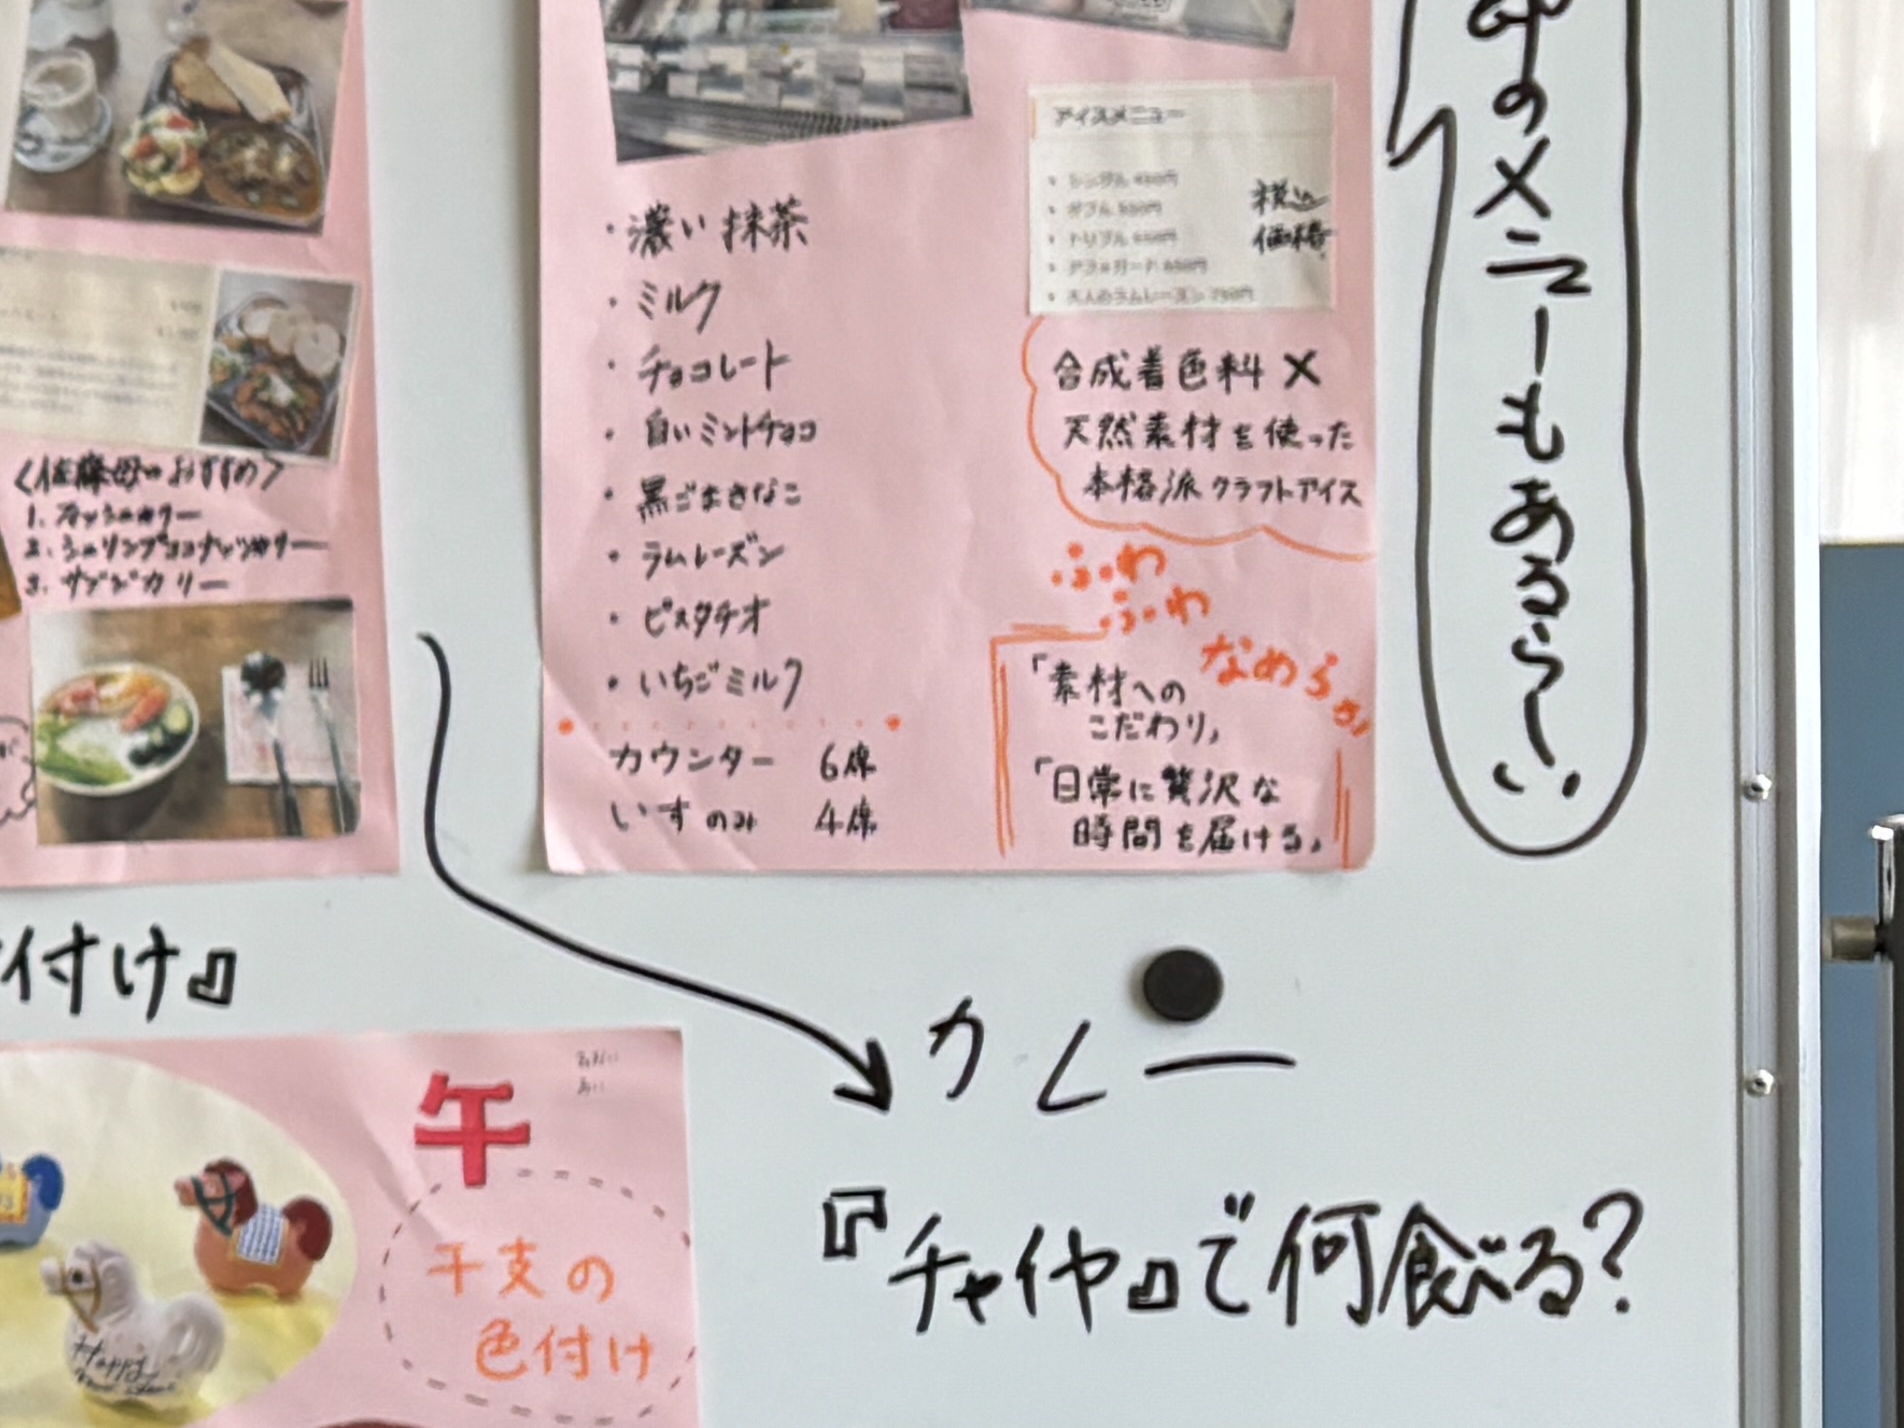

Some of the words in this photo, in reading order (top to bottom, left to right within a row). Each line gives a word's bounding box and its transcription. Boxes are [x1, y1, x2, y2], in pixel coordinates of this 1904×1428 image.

[635, 277, 724, 335] ミルク
[414, 1069, 531, 1189] 午
[473, 1319, 656, 1381] 色付け
